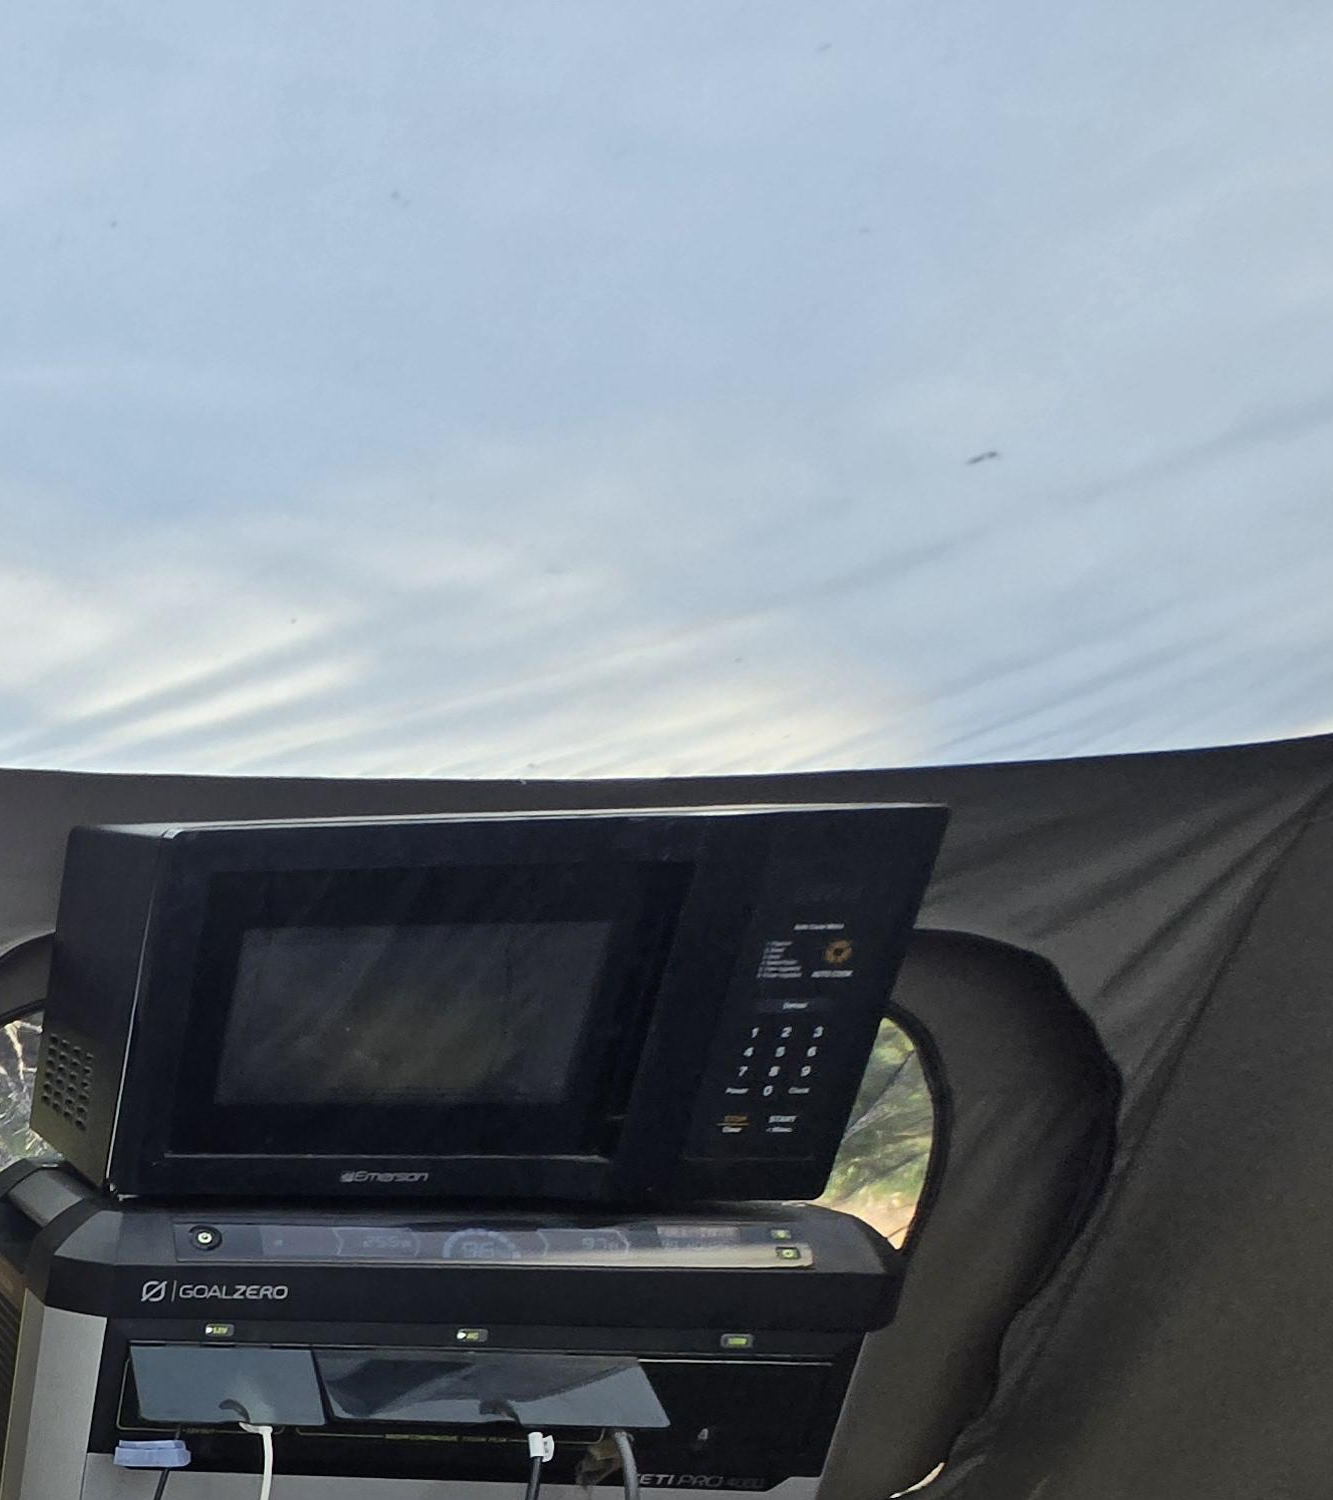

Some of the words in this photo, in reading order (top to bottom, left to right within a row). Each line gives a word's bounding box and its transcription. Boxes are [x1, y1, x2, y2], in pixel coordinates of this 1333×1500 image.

[751, 1027, 759, 1038] 1
[781, 1026, 792, 1038] 2
[813, 1026, 824, 1038] 3
[743, 1046, 754, 1057] 4
[775, 1046, 786, 1057] 5
[807, 1046, 818, 1057] 6
[738, 1066, 748, 1077] 7
[768, 1066, 780, 1077] 8
[800, 1066, 811, 1077] 9
[762, 1085, 773, 1096] 0
[355, 1170, 430, 1182] Emerson
[179, 1284, 289, 1300] GOALZERO
[636, 1473, 676, 1486] ETI
